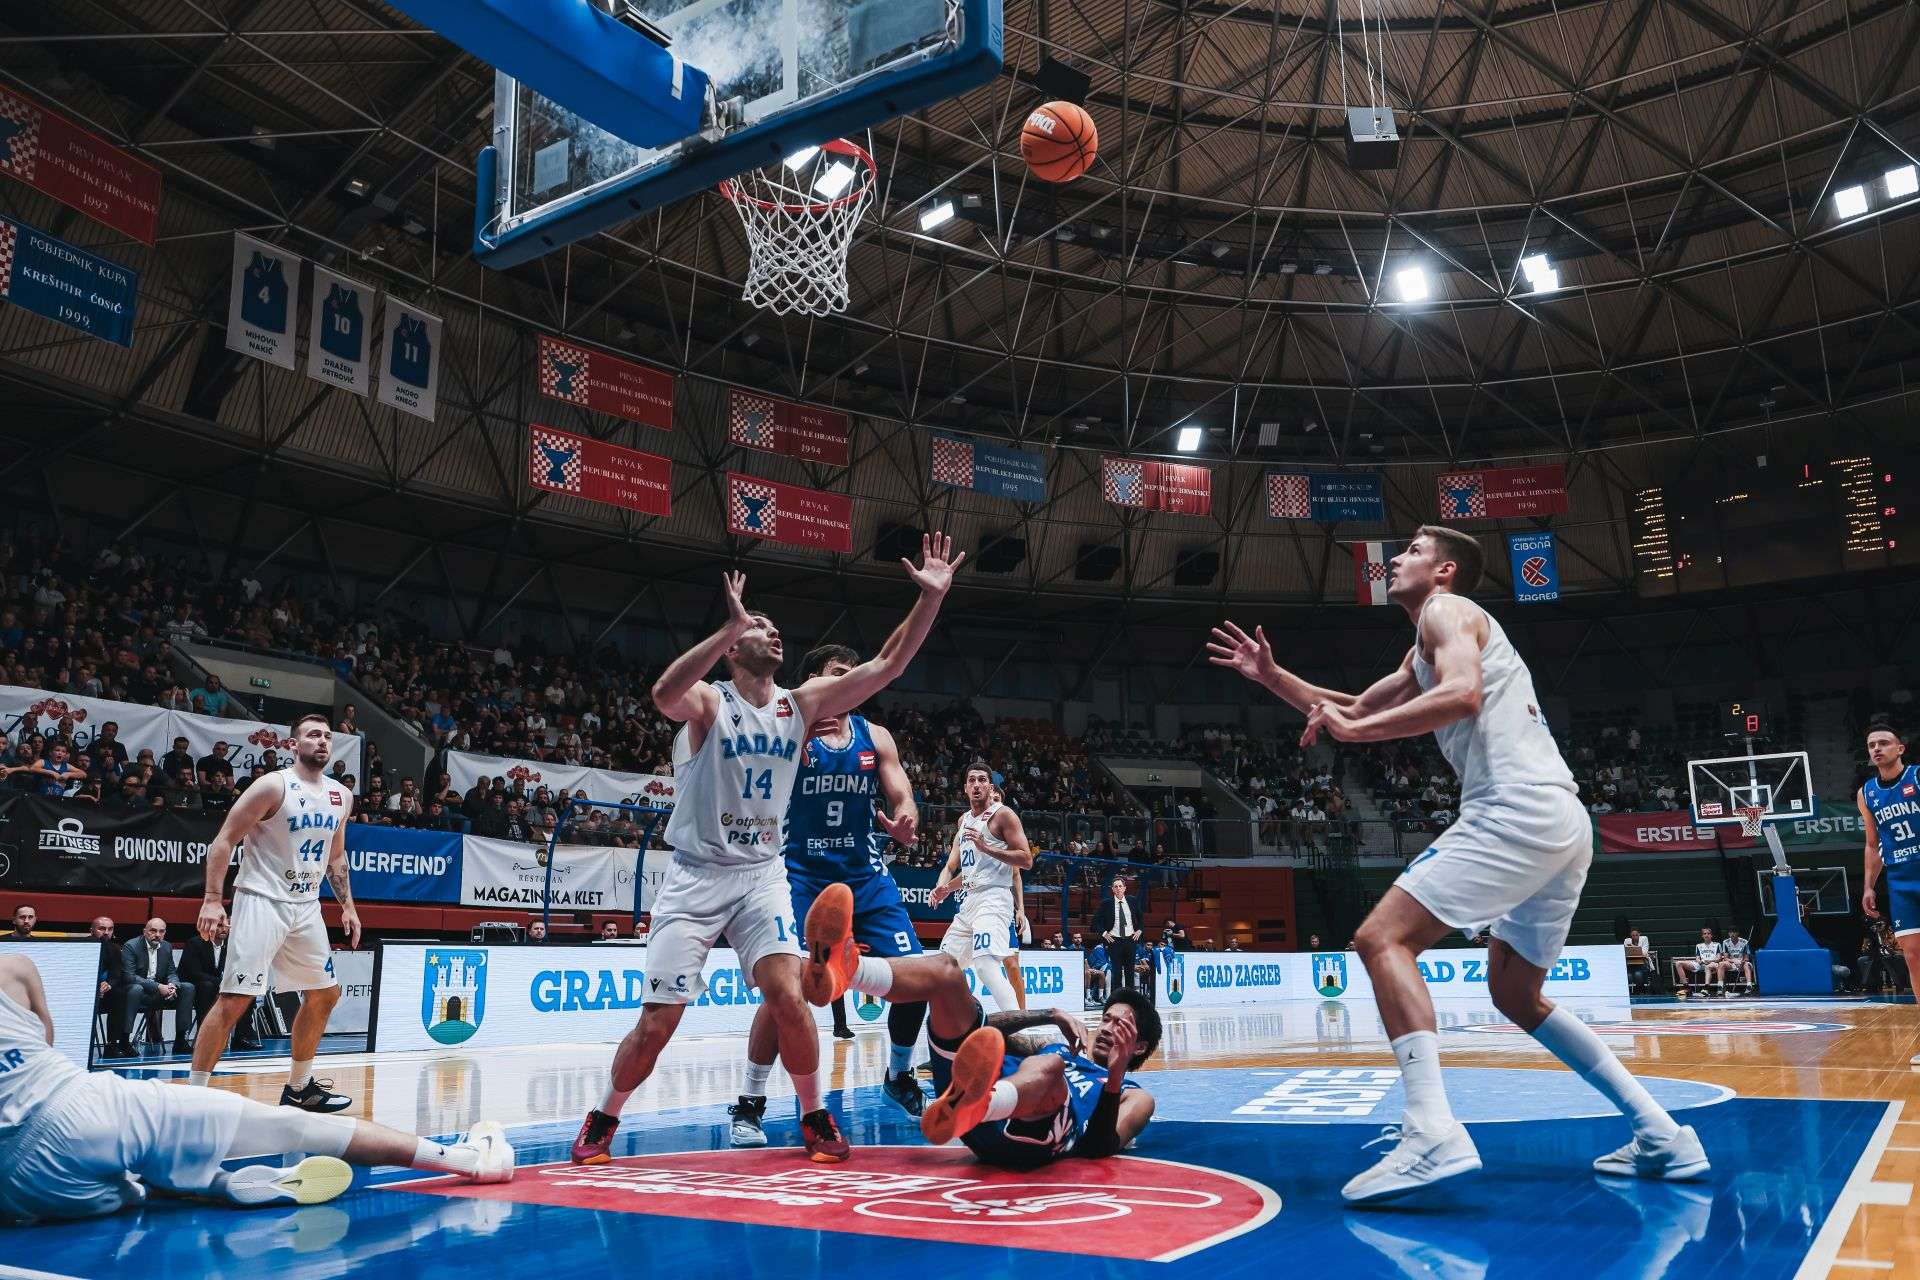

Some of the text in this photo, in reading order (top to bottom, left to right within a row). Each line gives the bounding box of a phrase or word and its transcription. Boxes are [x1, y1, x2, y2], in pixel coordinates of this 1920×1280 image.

[30, 236, 127, 287] POBJEDNIK KUPA
[23, 265, 82, 298] KREŠIMIR
[258, 286, 270, 304] 4
[334, 313, 350, 334] 10
[245, 330, 278, 348] MIHOVIL
[249, 341, 273, 356] NAKIĆ
[404, 342, 419, 363] 11
[322, 367, 355, 385] PETROVIĆ
[324, 358, 353, 375] DRAŽEN
[611, 456, 644, 471] PRVAK
[583, 465, 668, 491] REPUBLIKE HRVATSKE
[800, 499, 829, 512] PRVAK
[776, 510, 850, 530] REPUBLIKE HRVATSKE
[1513, 540, 1551, 551] CIBONA
[1518, 592, 1558, 601] ZAGREB
[720, 733, 798, 762] ZADAR
[742, 768, 772, 800] 14
[802, 774, 868, 795] CIBONA
[826, 800, 844, 827] 9
[1874, 800, 1920, 825] CIBONA
[1637, 826, 1694, 843] ERSTE
[1795, 816, 1856, 835] ERSTE
[1890, 820, 1916, 842] 31
[46, 833, 100, 851] FITNESS
[728, 830, 761, 845] PSK
[806, 837, 842, 849] ERSTE
[114, 836, 182, 863] PONOSNI
[300, 838, 325, 861] 44
[961, 850, 976, 867] 20
[1893, 846, 1918, 859] ERSTE
[519, 874, 563, 884] RESTOAN
[474, 886, 604, 906] MAGAZINKA KLET
[898, 887, 931, 903] RSTE
[894, 931, 912, 952] 9
[973, 932, 991, 951] 20
[1196, 964, 1281, 988] GRAD ZAGREB
[530, 970, 645, 1013] GRAD
